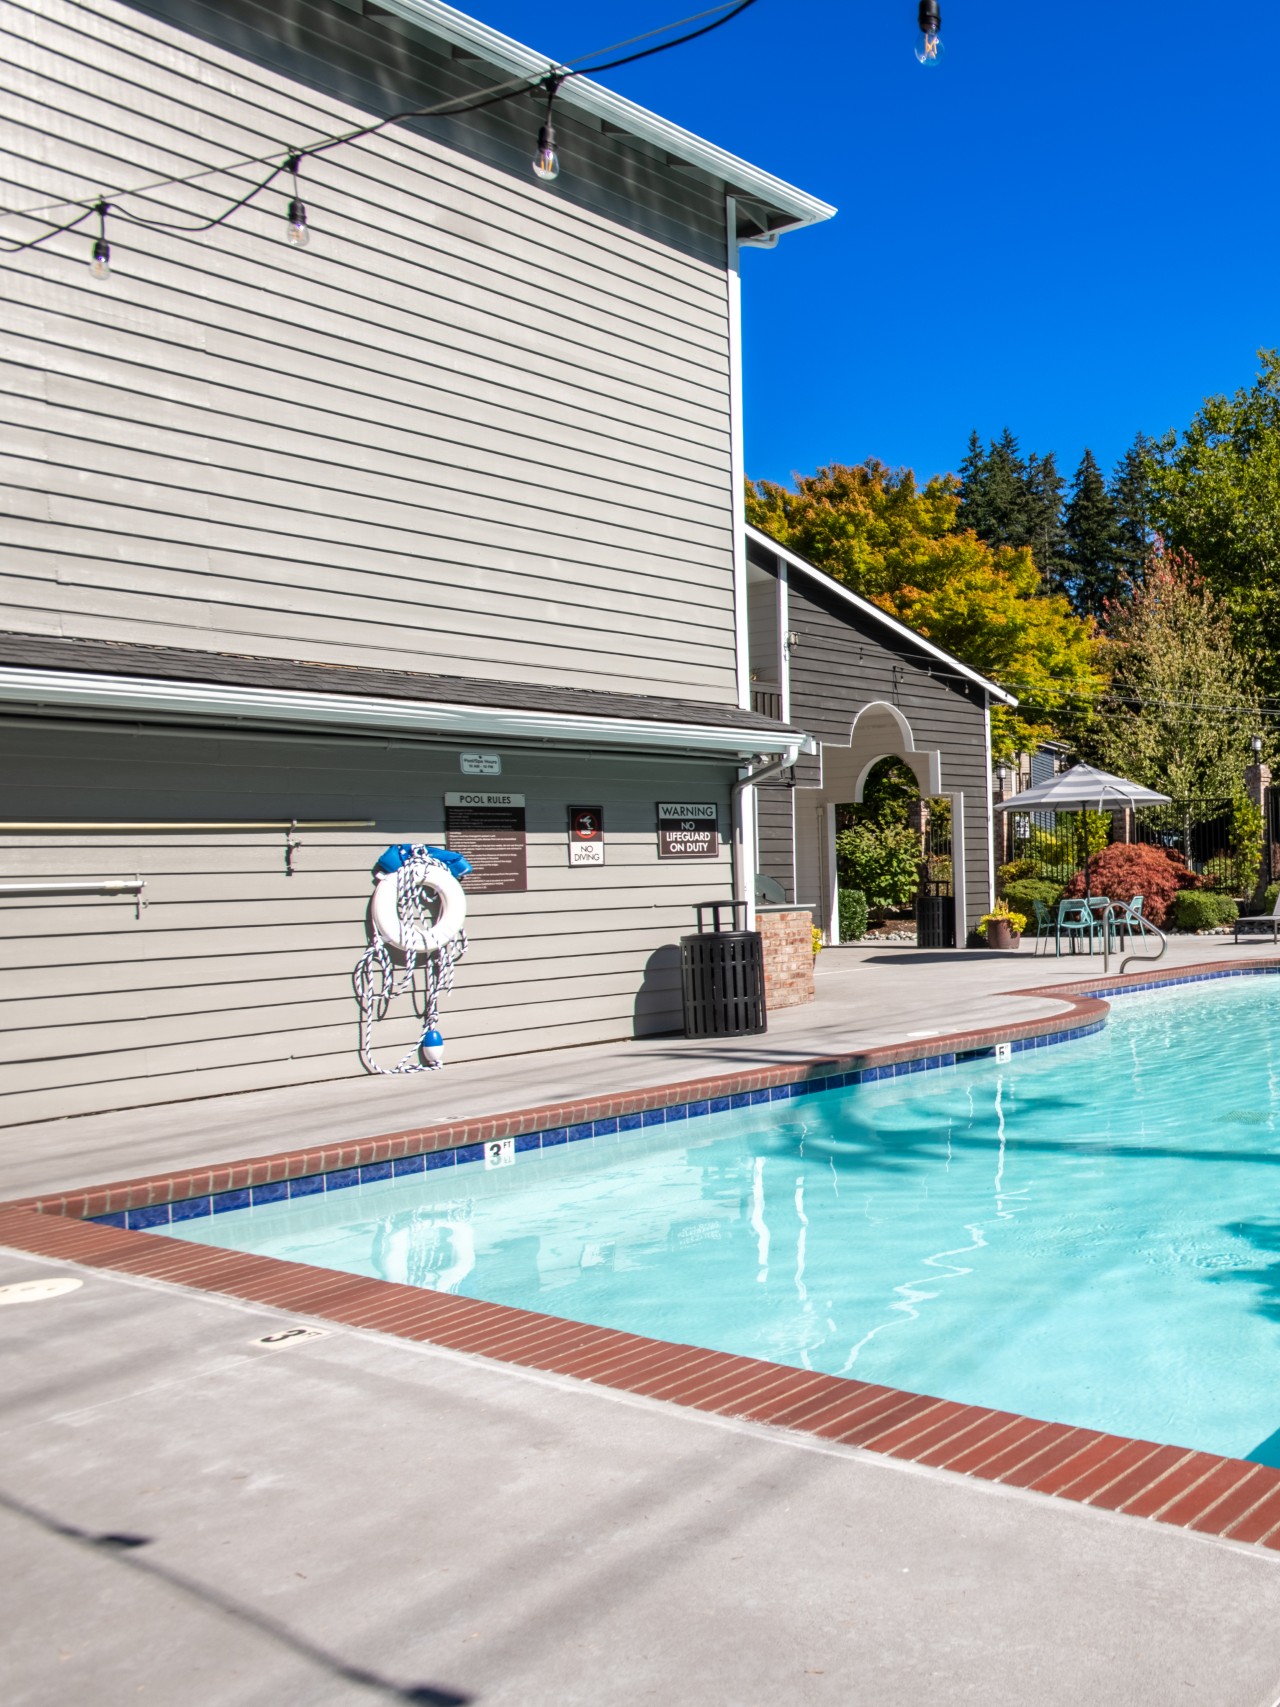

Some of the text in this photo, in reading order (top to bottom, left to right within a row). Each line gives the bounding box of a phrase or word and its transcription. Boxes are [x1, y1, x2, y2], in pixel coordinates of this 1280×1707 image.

[459, 795, 511, 805] POOL RULES
[661, 806, 714, 817] WARNING
[681, 821, 695, 830] NO
[666, 832, 711, 842] LIFEGUARD
[580, 845, 594, 853] NO
[670, 842, 708, 852] ON DUTY
[574, 853, 600, 862] DIVING
[489, 1141, 512, 1157] 3 FT
[260, 1329, 307, 1343] 3
